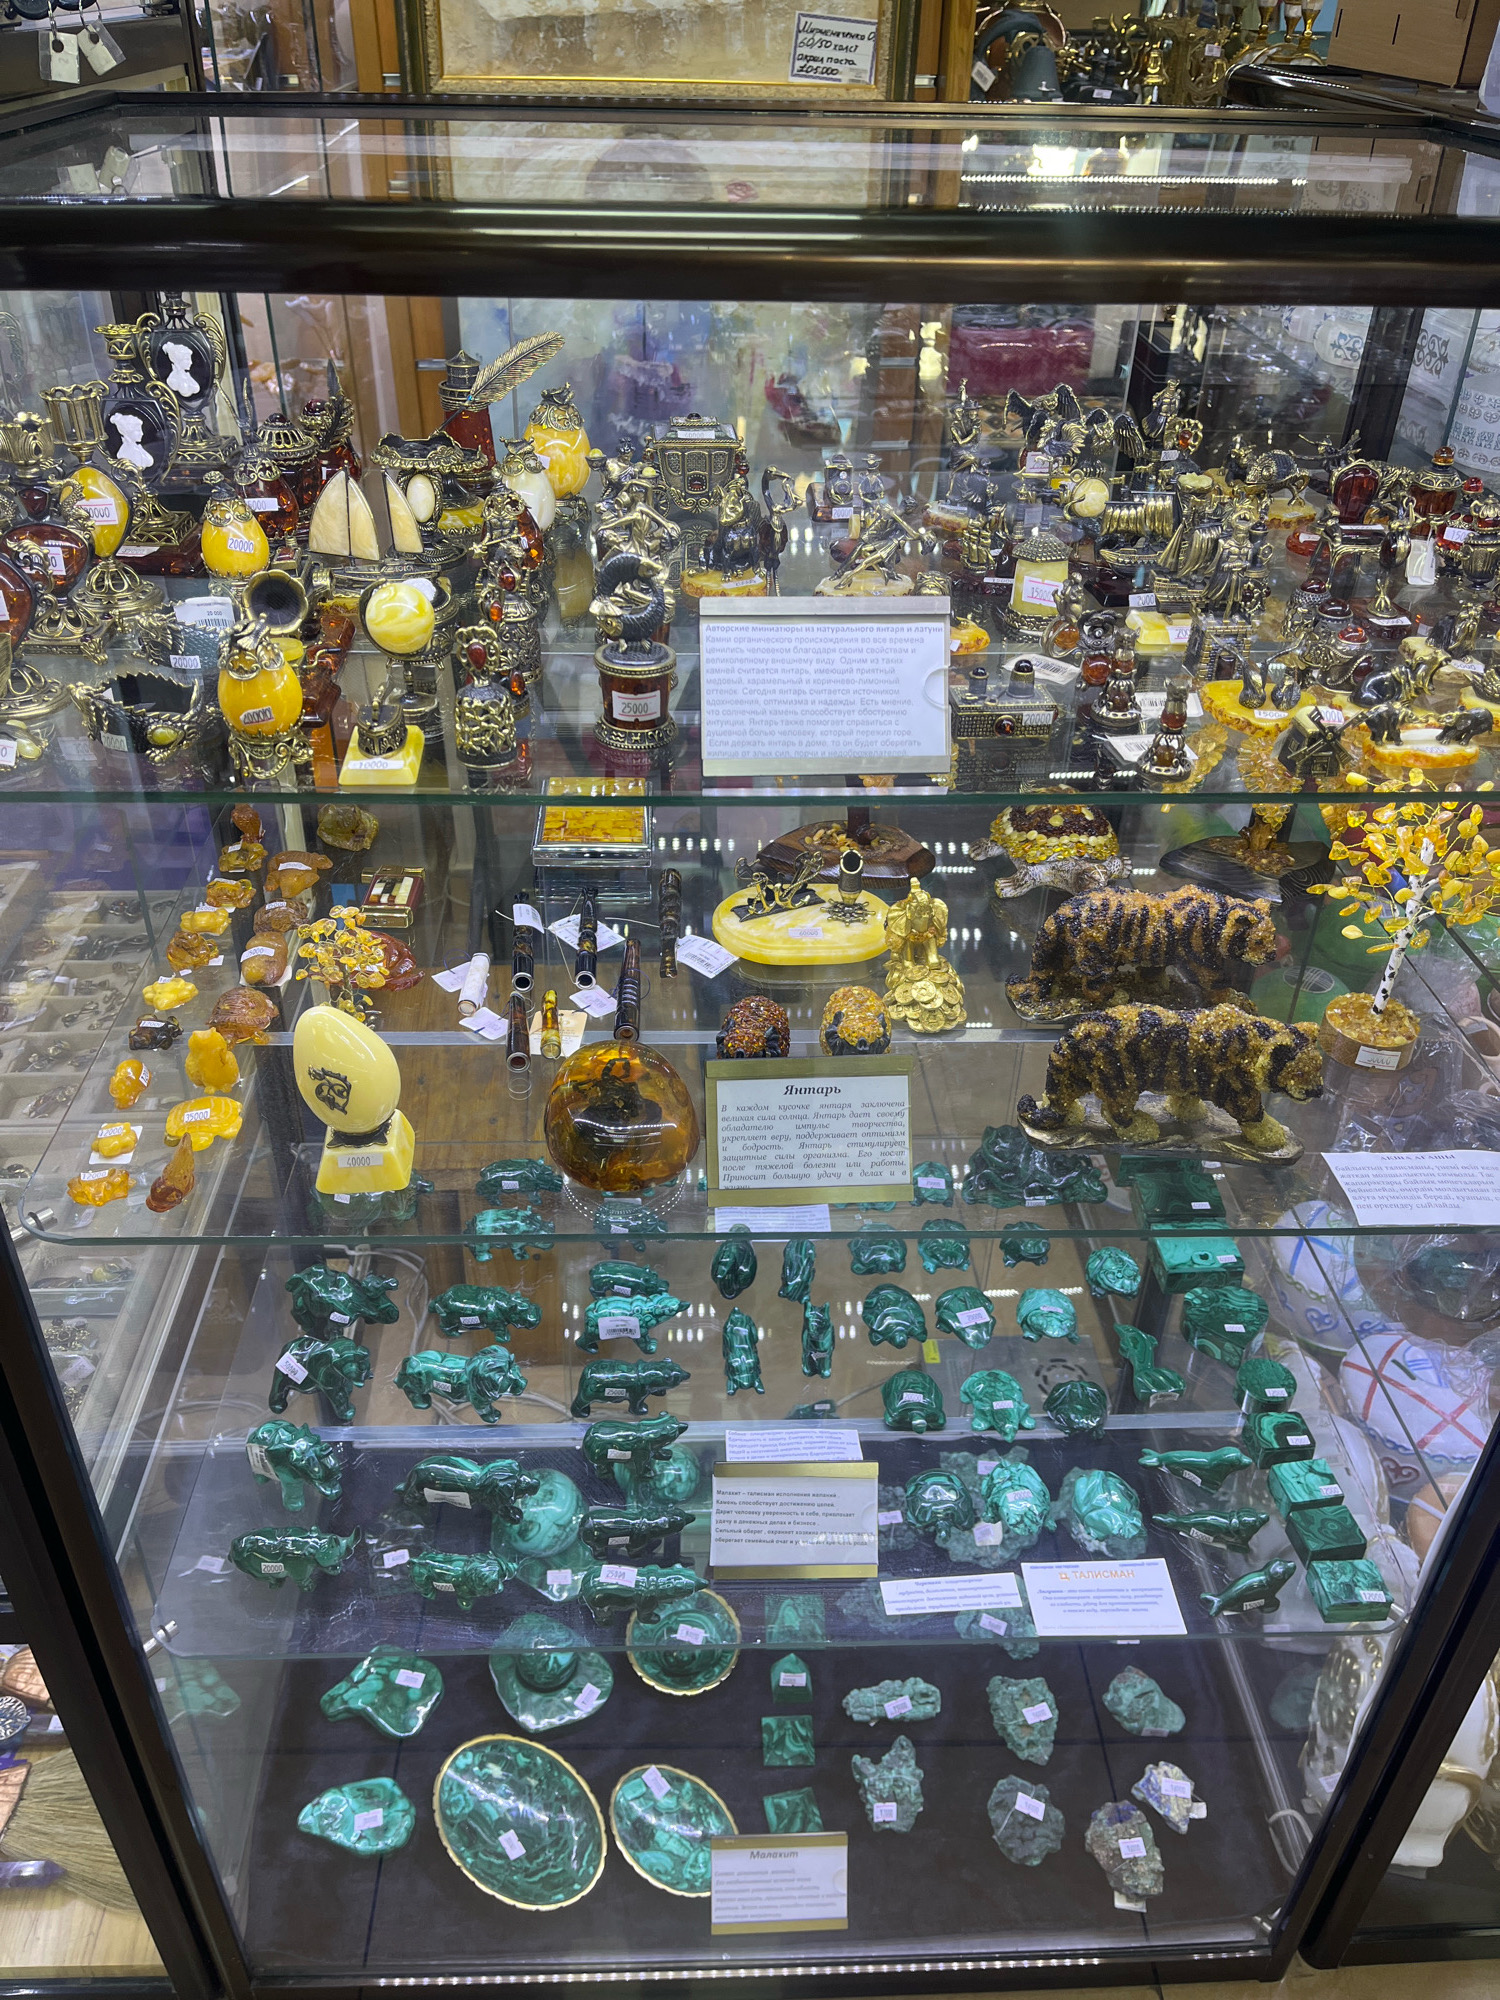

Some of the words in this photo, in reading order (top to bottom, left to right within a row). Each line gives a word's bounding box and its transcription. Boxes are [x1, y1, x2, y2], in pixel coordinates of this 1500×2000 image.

[229, 538, 254, 553] 20000
[706, 625, 750, 634] Авторские
[751, 625, 802, 634] миниатюры
[805, 625, 815, 634] из
[817, 625, 874, 634] натурального
[876, 625, 905, 634] янтаря
[914, 625, 943, 634] латуни
[706, 636, 732, 645] Камни
[734, 636, 792, 645] органического
[889, 636, 924, 645] времена
[172, 656, 200, 668] 20000
[621, 702, 649, 714] 25000
[860, 698, 880, 707] Есть
[749, 718, 778, 728] Янтарь
[1025, 713, 1051, 725] 20000
[709, 739, 729, 748] Если
[783, 1085, 842, 1096] Янтарь
[736, 1104, 770, 1112] каждом
[778, 1104, 810, 1112] кусочке
[861, 1101, 906, 1109] заключена
[184, 1110, 209, 1121] 35000
[778, 1114, 810, 1122] солнца.
[812, 1112, 846, 1120] Янтарь
[849, 1110, 871, 1118] дает
[721, 1124, 774, 1132] обладателю
[795, 1123, 830, 1131] импульс
[851, 1121, 906, 1129] творчества,
[721, 1135, 766, 1144] укрепляет
[771, 1134, 792, 1142] веру,
[796, 1131, 858, 1140] поддерживает
[742, 1143, 784, 1152] бодрость.
[798, 1142, 832, 1150] Янтарь
[846, 1140, 906, 1148] стимулирует
[346, 1157, 371, 1166] 40000
[722, 1153, 768, 1162] защитные
[803, 1152, 850, 1160] организма.
[858, 1150, 873, 1158] Его
[755, 1162, 794, 1170] тяжелой
[870, 1159, 907, 1168] работы.
[723, 1173, 766, 1183] Приносит
[772, 1172, 811, 1180] большую
[817, 1170, 842, 1180] удачу
[860, 1169, 884, 1177] делах
[762, 1510, 799, 1518] уверенность
[263, 1564, 283, 1572] 20000
[1071, 1569, 1135, 1580] ТАЛИСМАН
[750, 1851, 799, 1861] Малахит
